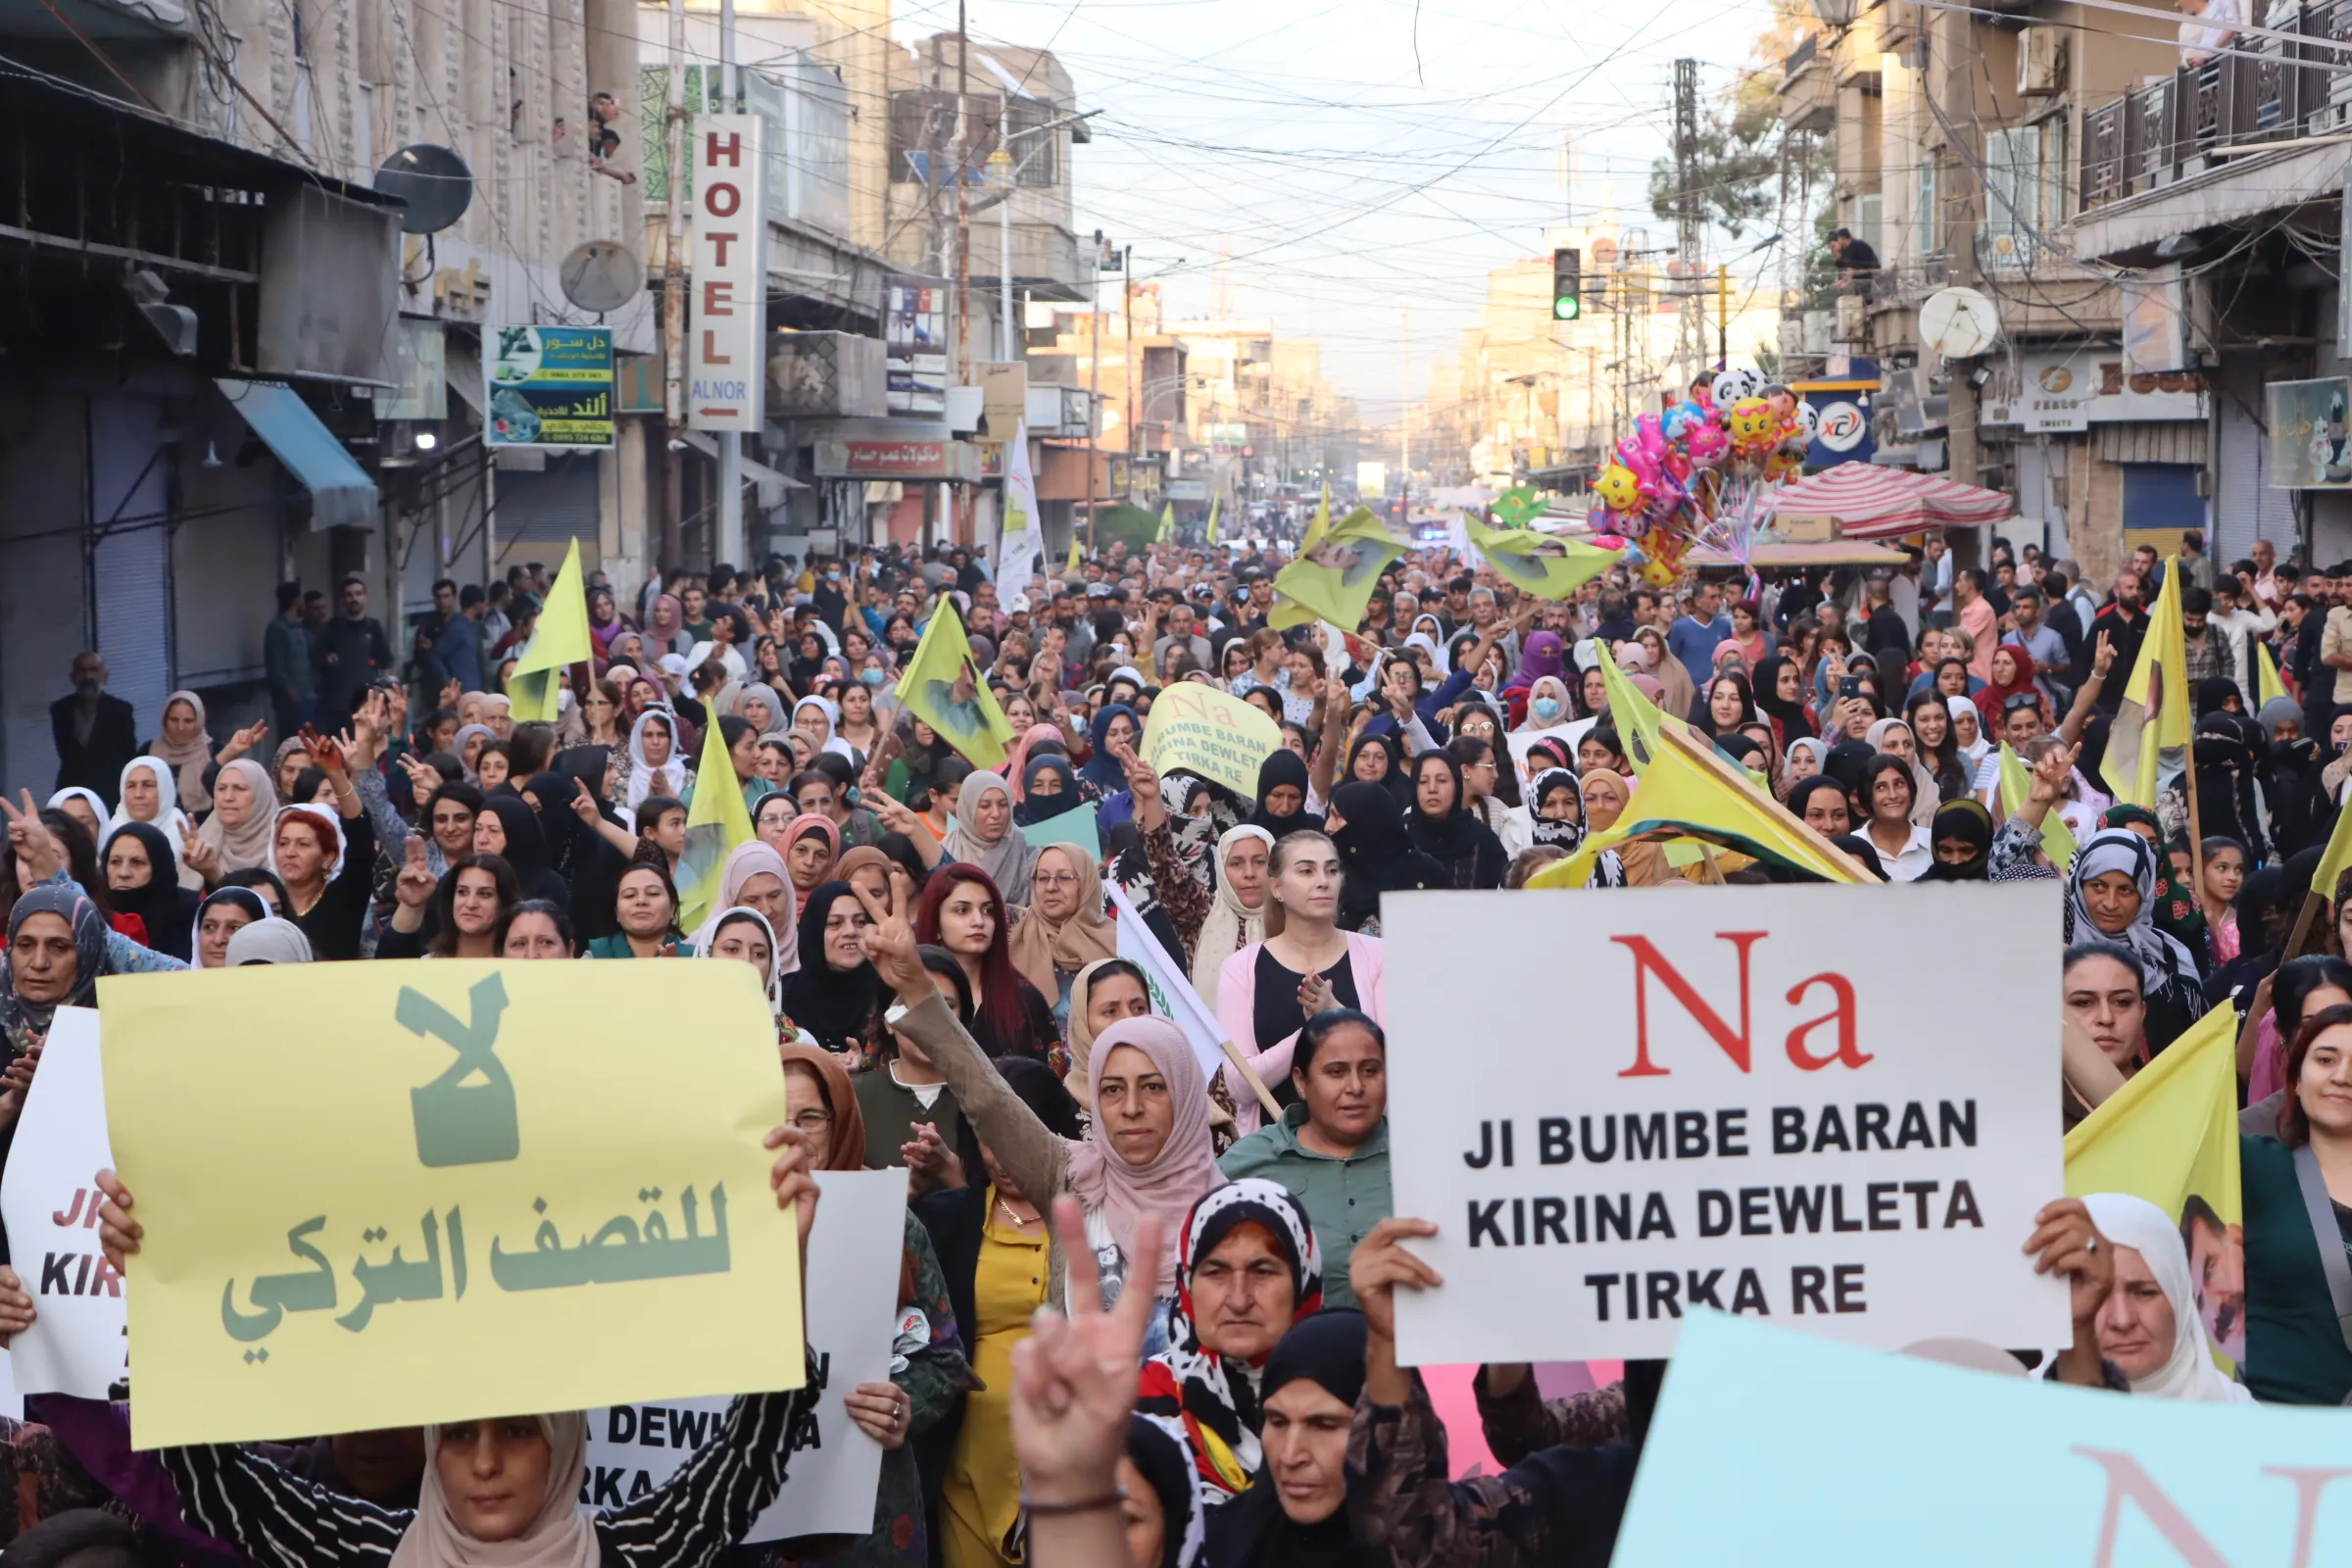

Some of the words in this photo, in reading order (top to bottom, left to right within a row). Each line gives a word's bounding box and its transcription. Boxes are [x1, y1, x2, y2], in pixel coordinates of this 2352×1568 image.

[703, 131, 741, 365] HOTEL
[692, 379, 746, 400] ALNOR
[1157, 722, 1212, 744] BUMBE
[1216, 728, 1266, 755] BARAN
[1164, 690, 1238, 728] Na
[1173, 751, 1221, 774] TIRKA
[1224, 765, 1244, 784] RE
[1200, 739, 1262, 771] DEWLET
[1609, 930, 1875, 1078] Na
[394, 971, 520, 1168] لا
[1462, 1119, 1514, 1169] JI
[1538, 1108, 1749, 1165] BUMBE
[1771, 1100, 1978, 1154] BARAN
[490, 1180, 731, 1293] للقصف
[1467, 1192, 1677, 1248] KIRINA
[1696, 1179, 1984, 1238] DEWLETA
[40, 1251, 126, 1298] KIR
[221, 1203, 467, 1364] التركي
[1584, 1266, 1771, 1321] TIRKA
[1790, 1263, 1868, 1315] RE
